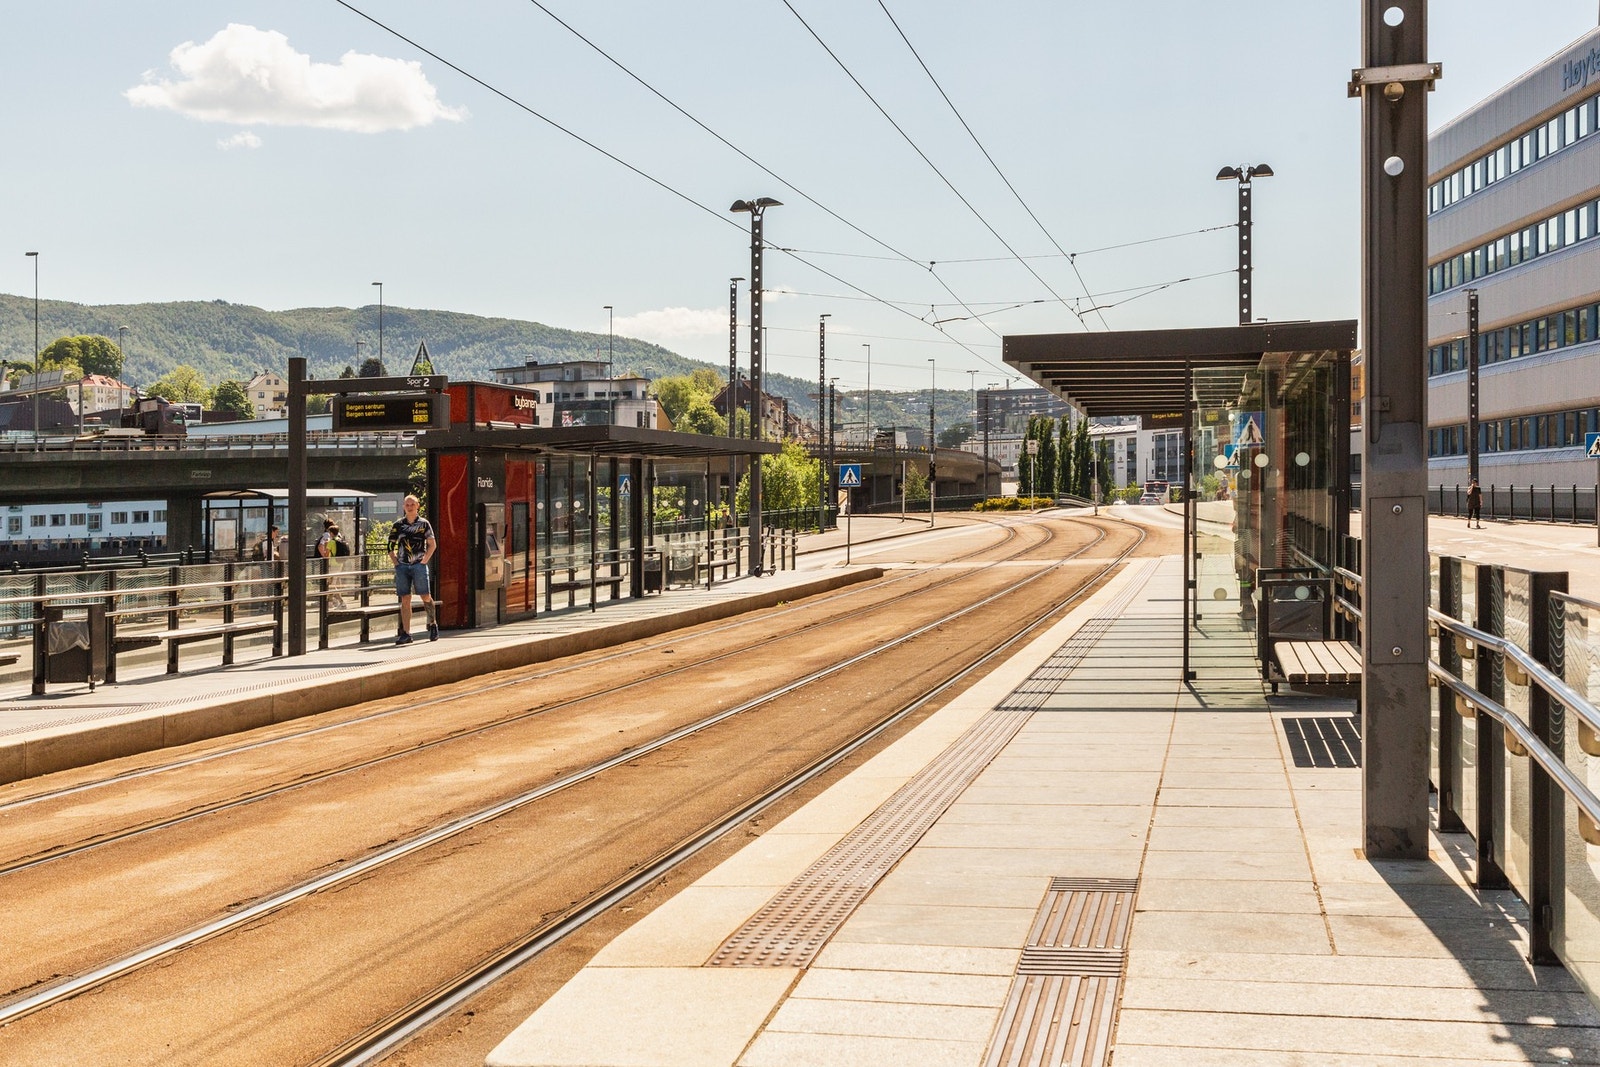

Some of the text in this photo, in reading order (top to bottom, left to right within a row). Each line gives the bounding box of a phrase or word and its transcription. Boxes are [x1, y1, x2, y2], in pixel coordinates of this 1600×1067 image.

[424, 378, 430, 386] 2
[515, 395, 537, 410] bybanen
[478, 476, 493, 487] Florida
